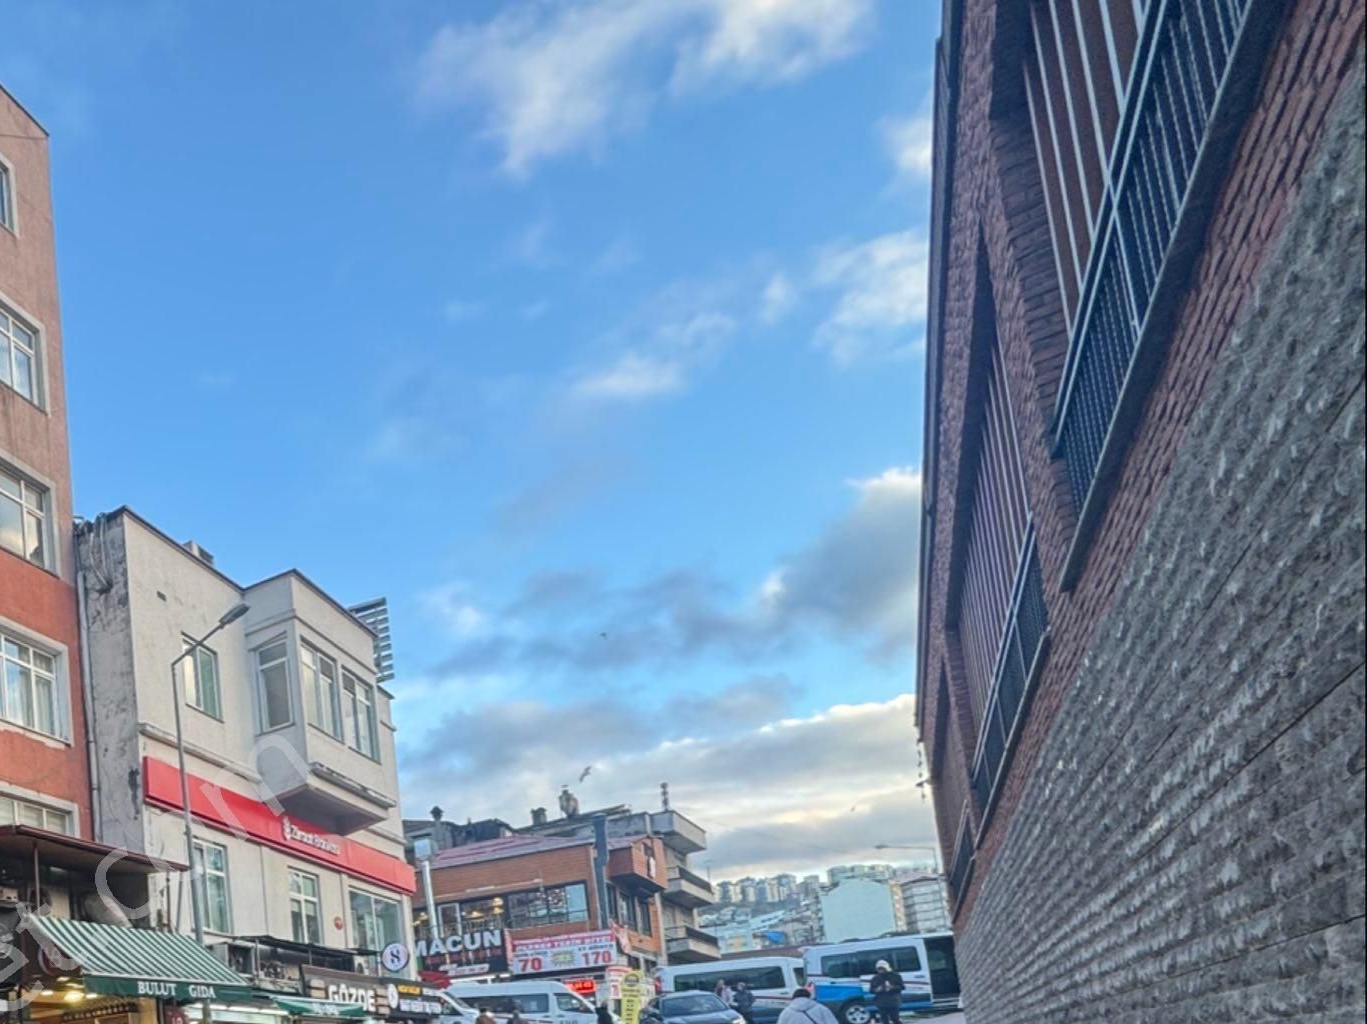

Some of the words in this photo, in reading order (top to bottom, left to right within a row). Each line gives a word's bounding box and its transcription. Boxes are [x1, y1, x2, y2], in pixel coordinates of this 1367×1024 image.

[518, 957, 543, 973] 70
[582, 950, 612, 966] 170
[137, 981, 177, 996] BULUT
[188, 985, 216, 999] GIDA
